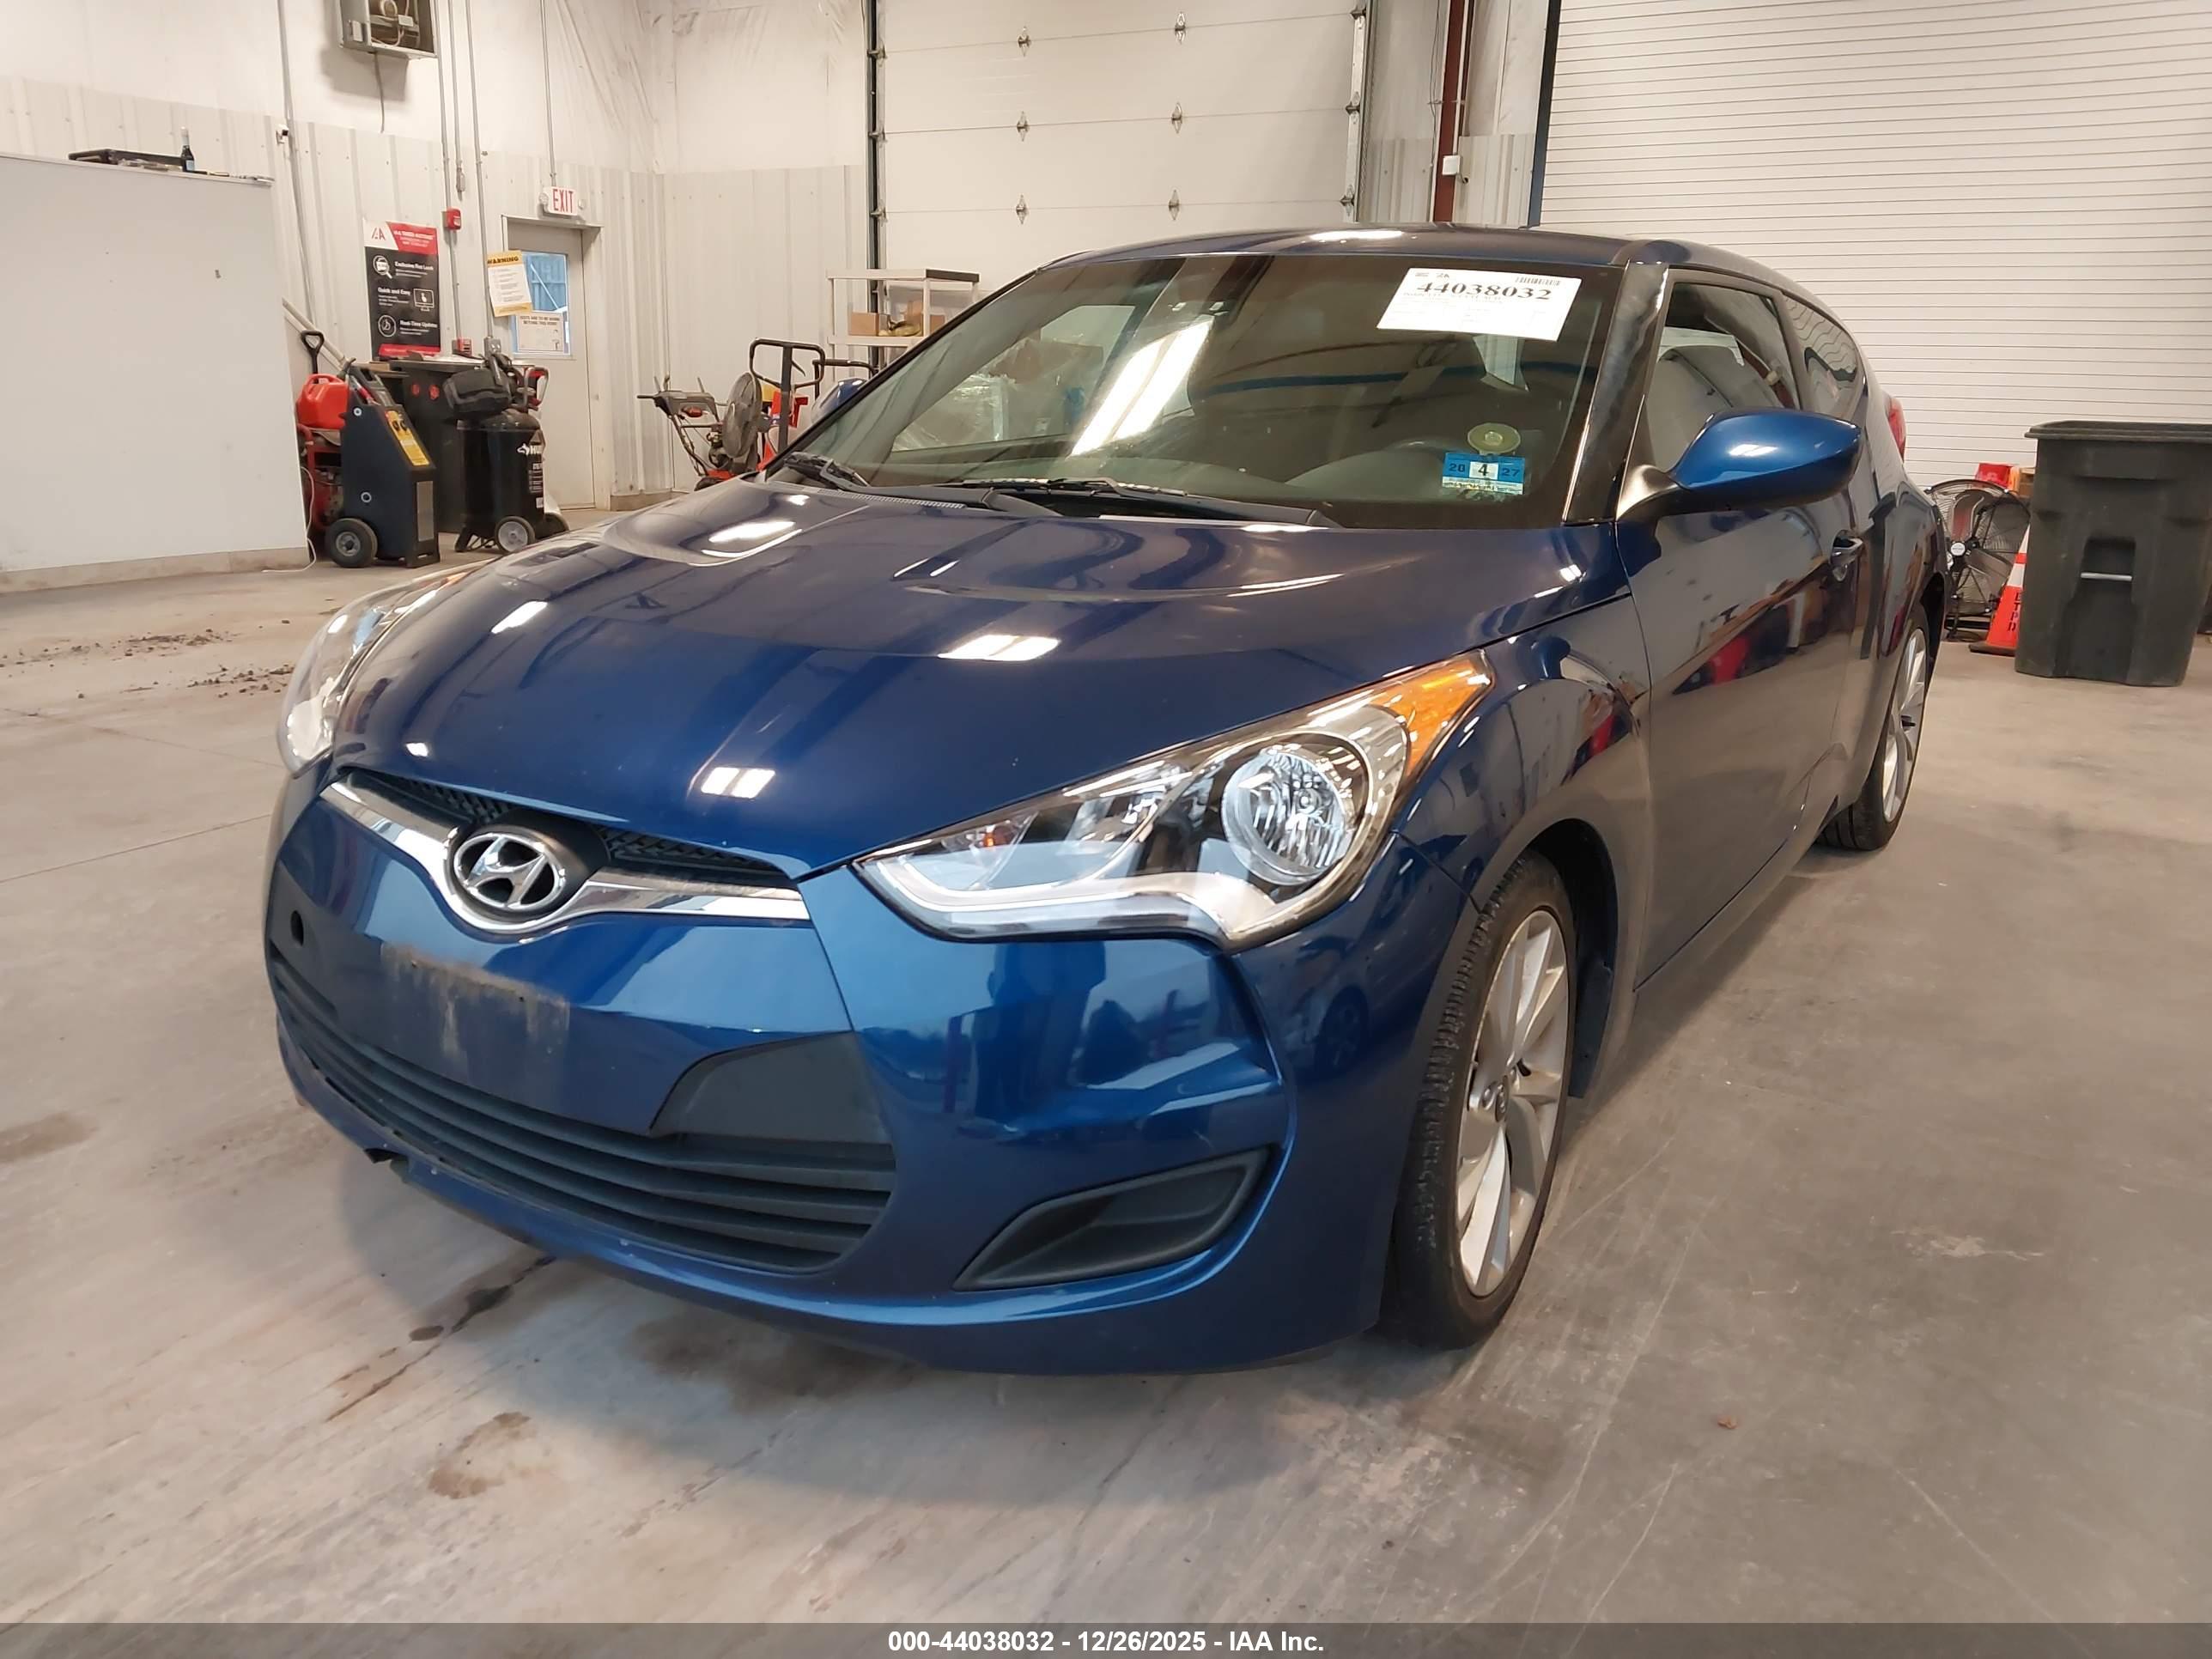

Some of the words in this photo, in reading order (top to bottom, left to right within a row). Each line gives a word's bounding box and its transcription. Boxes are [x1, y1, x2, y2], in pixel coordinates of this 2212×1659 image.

[552, 188, 574, 213] EXIT
[1416, 281, 1553, 301] 44038032
[1449, 463, 1466, 473] 20
[1478, 464, 1489, 477] 4
[1501, 467, 1520, 477] 27
